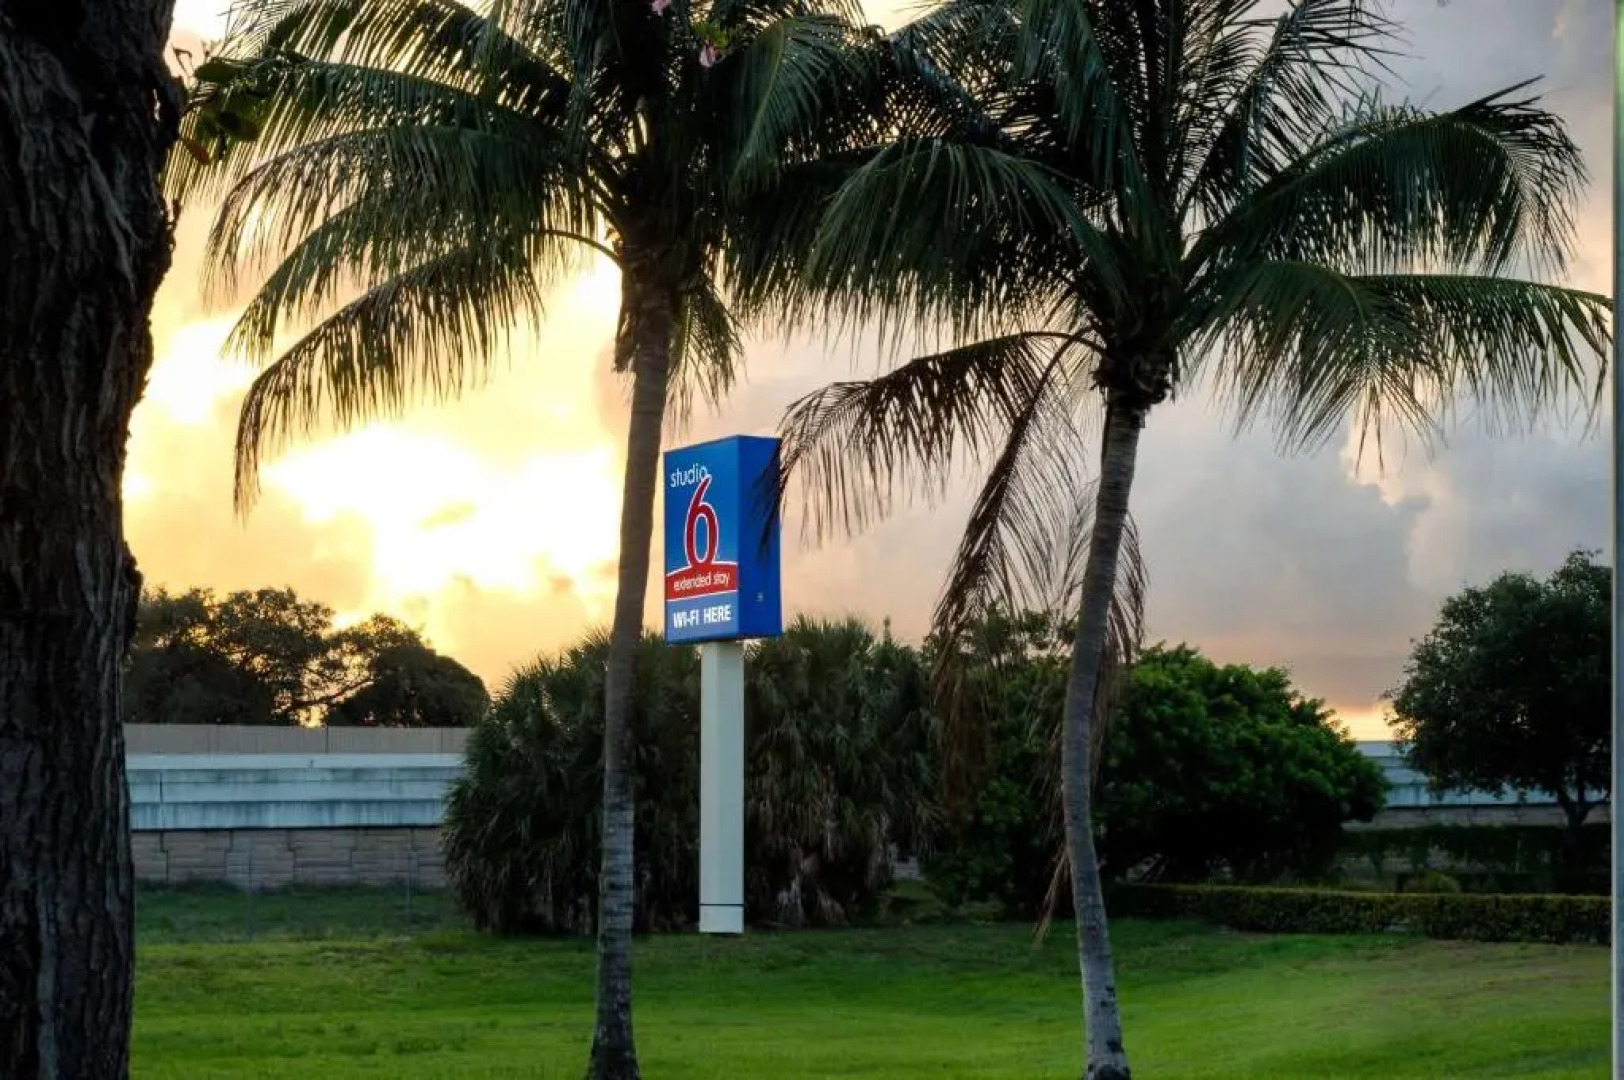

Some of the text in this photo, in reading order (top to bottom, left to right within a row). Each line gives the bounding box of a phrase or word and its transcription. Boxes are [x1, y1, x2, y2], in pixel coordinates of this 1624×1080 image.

[670, 463, 709, 488] studio
[684, 474, 719, 566] 6
[673, 570, 731, 592] extended stay
[673, 603, 732, 629] WI-FI HERE
